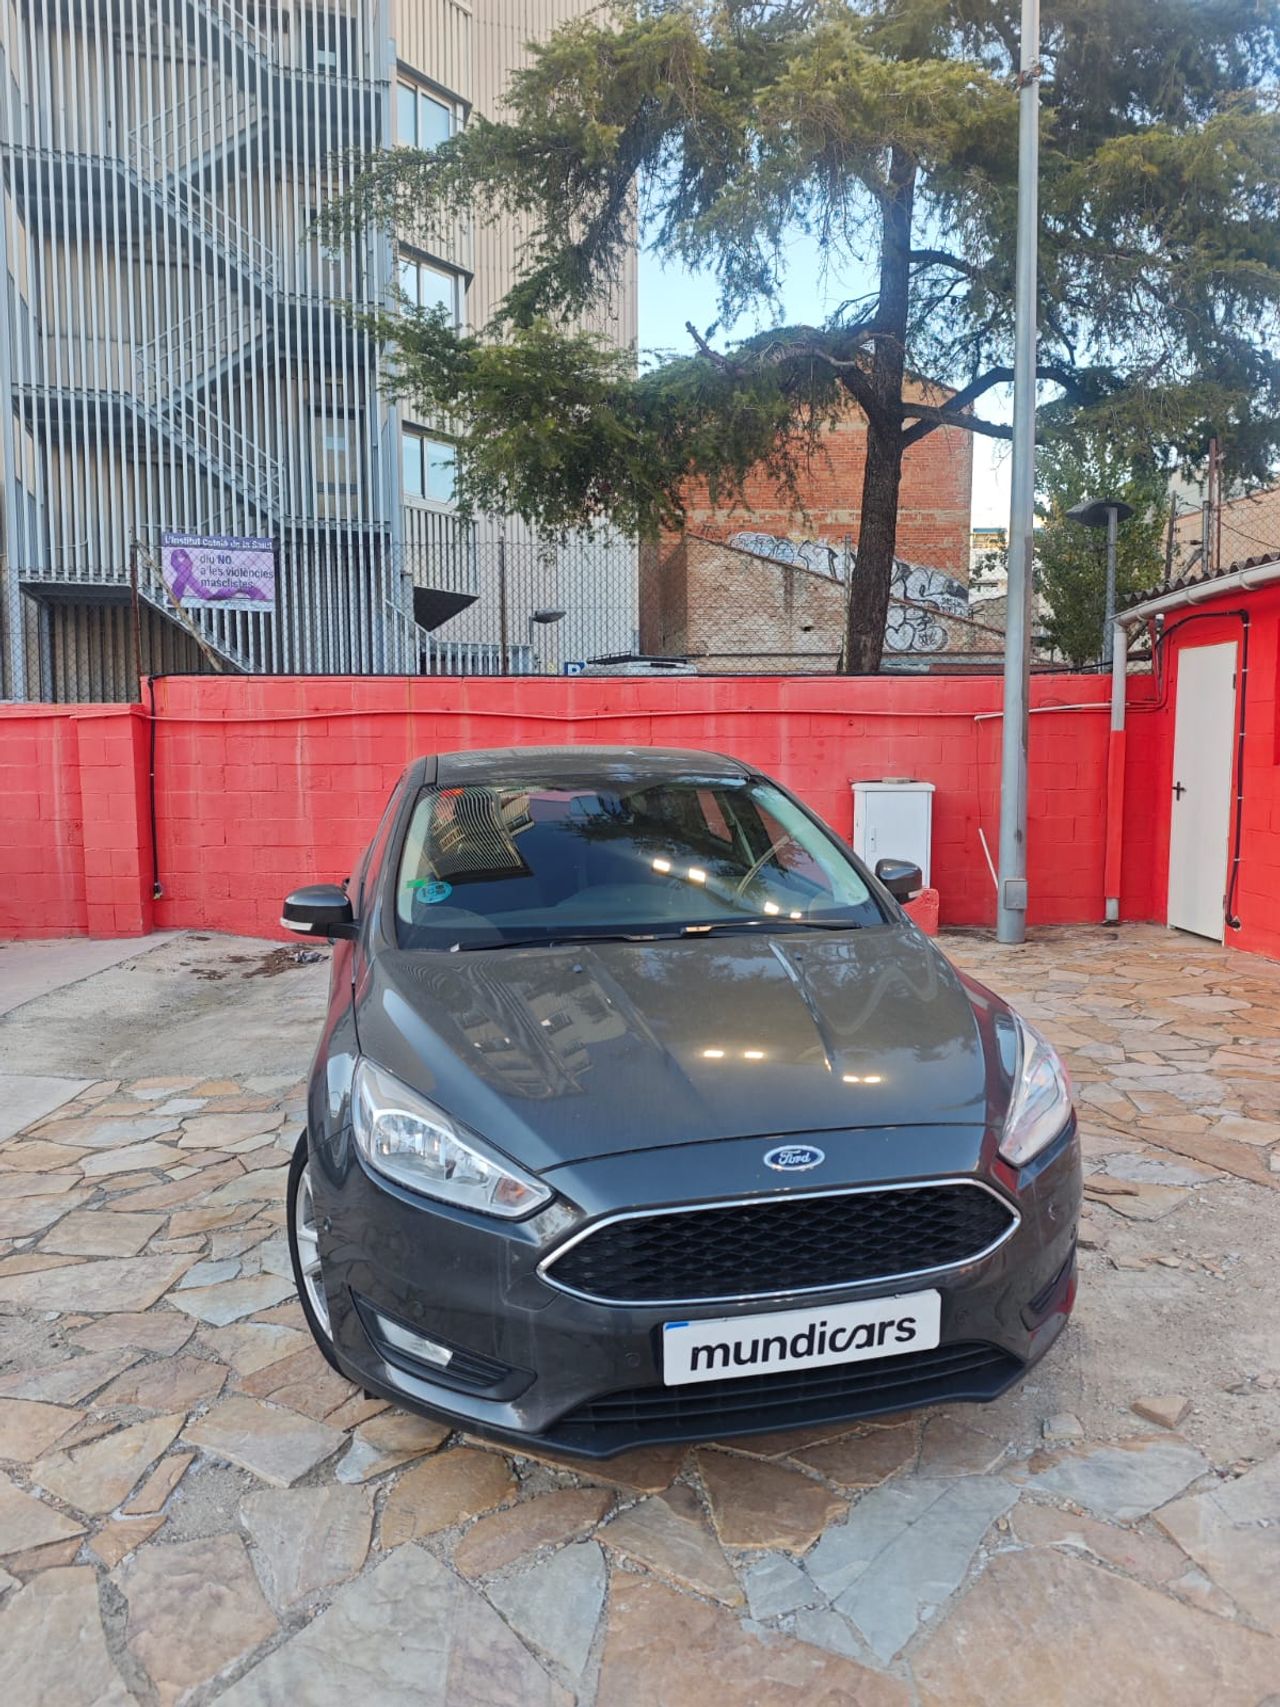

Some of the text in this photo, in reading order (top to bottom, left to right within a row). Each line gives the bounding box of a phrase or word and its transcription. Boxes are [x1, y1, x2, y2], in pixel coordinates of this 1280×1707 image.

[200, 554, 232, 565] diu NO
[200, 567, 206, 575] a
[209, 566, 223, 576] les
[201, 578, 253, 588] masclistes
[778, 1149, 811, 1165] Ford
[690, 1317, 917, 1371] mundicars
